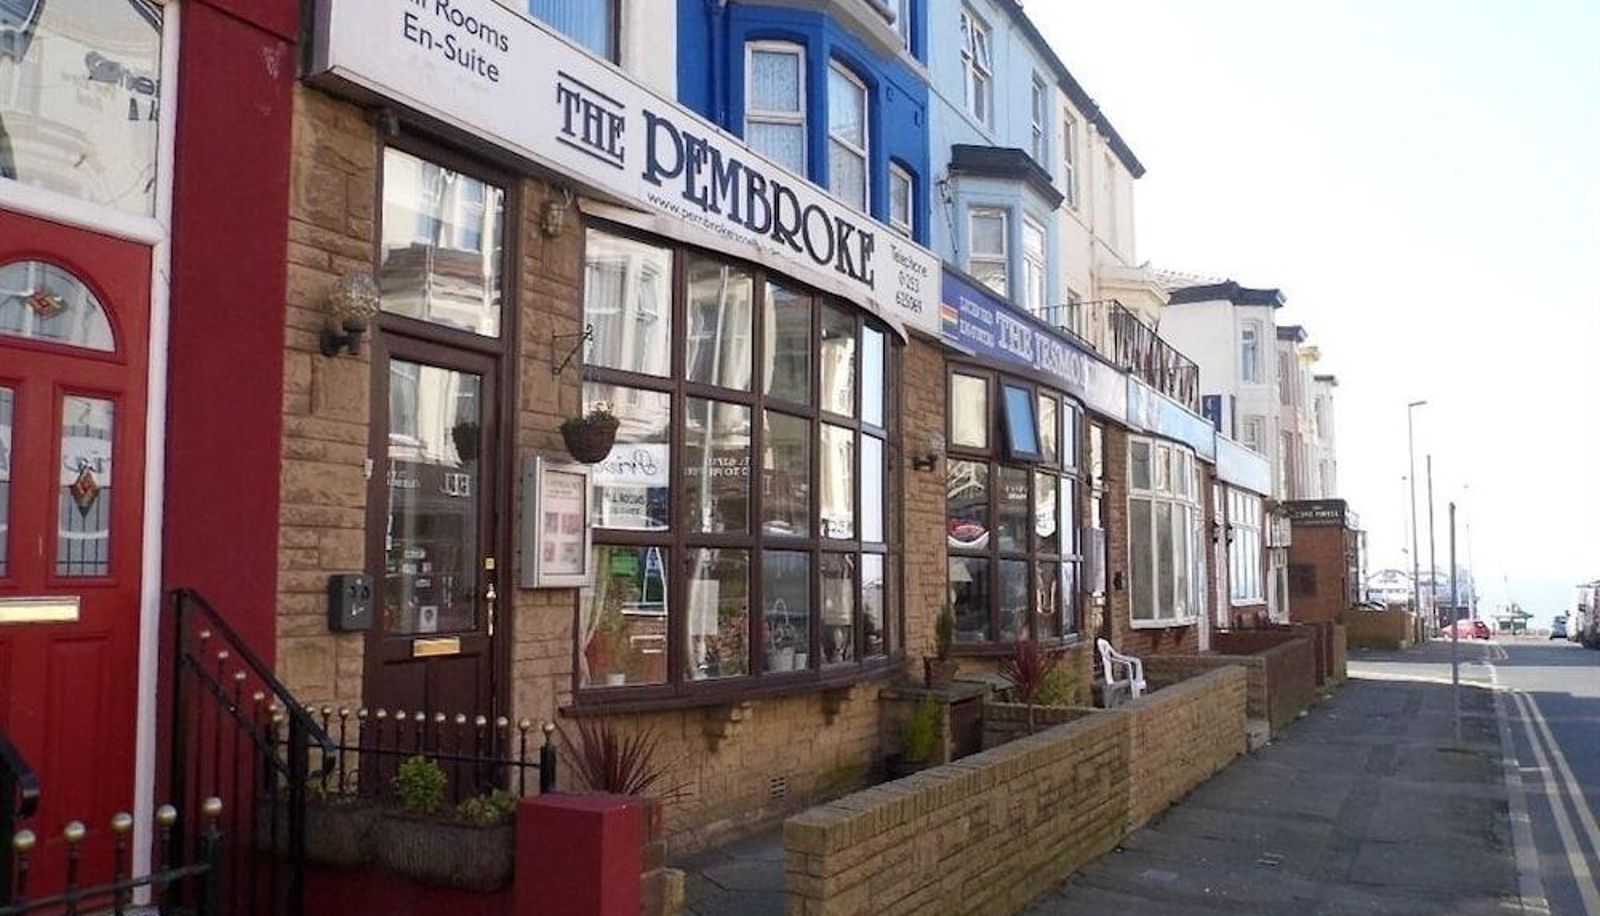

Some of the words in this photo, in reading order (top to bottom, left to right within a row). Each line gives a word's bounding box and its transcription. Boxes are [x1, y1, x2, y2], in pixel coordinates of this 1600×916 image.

[404, 12, 500, 83] En-Suite
[436, 0, 509, 52] Rooms
[556, 82, 625, 163] THE
[642, 109, 875, 290] PEMBROKE
[996, 311, 1034, 363] THE
